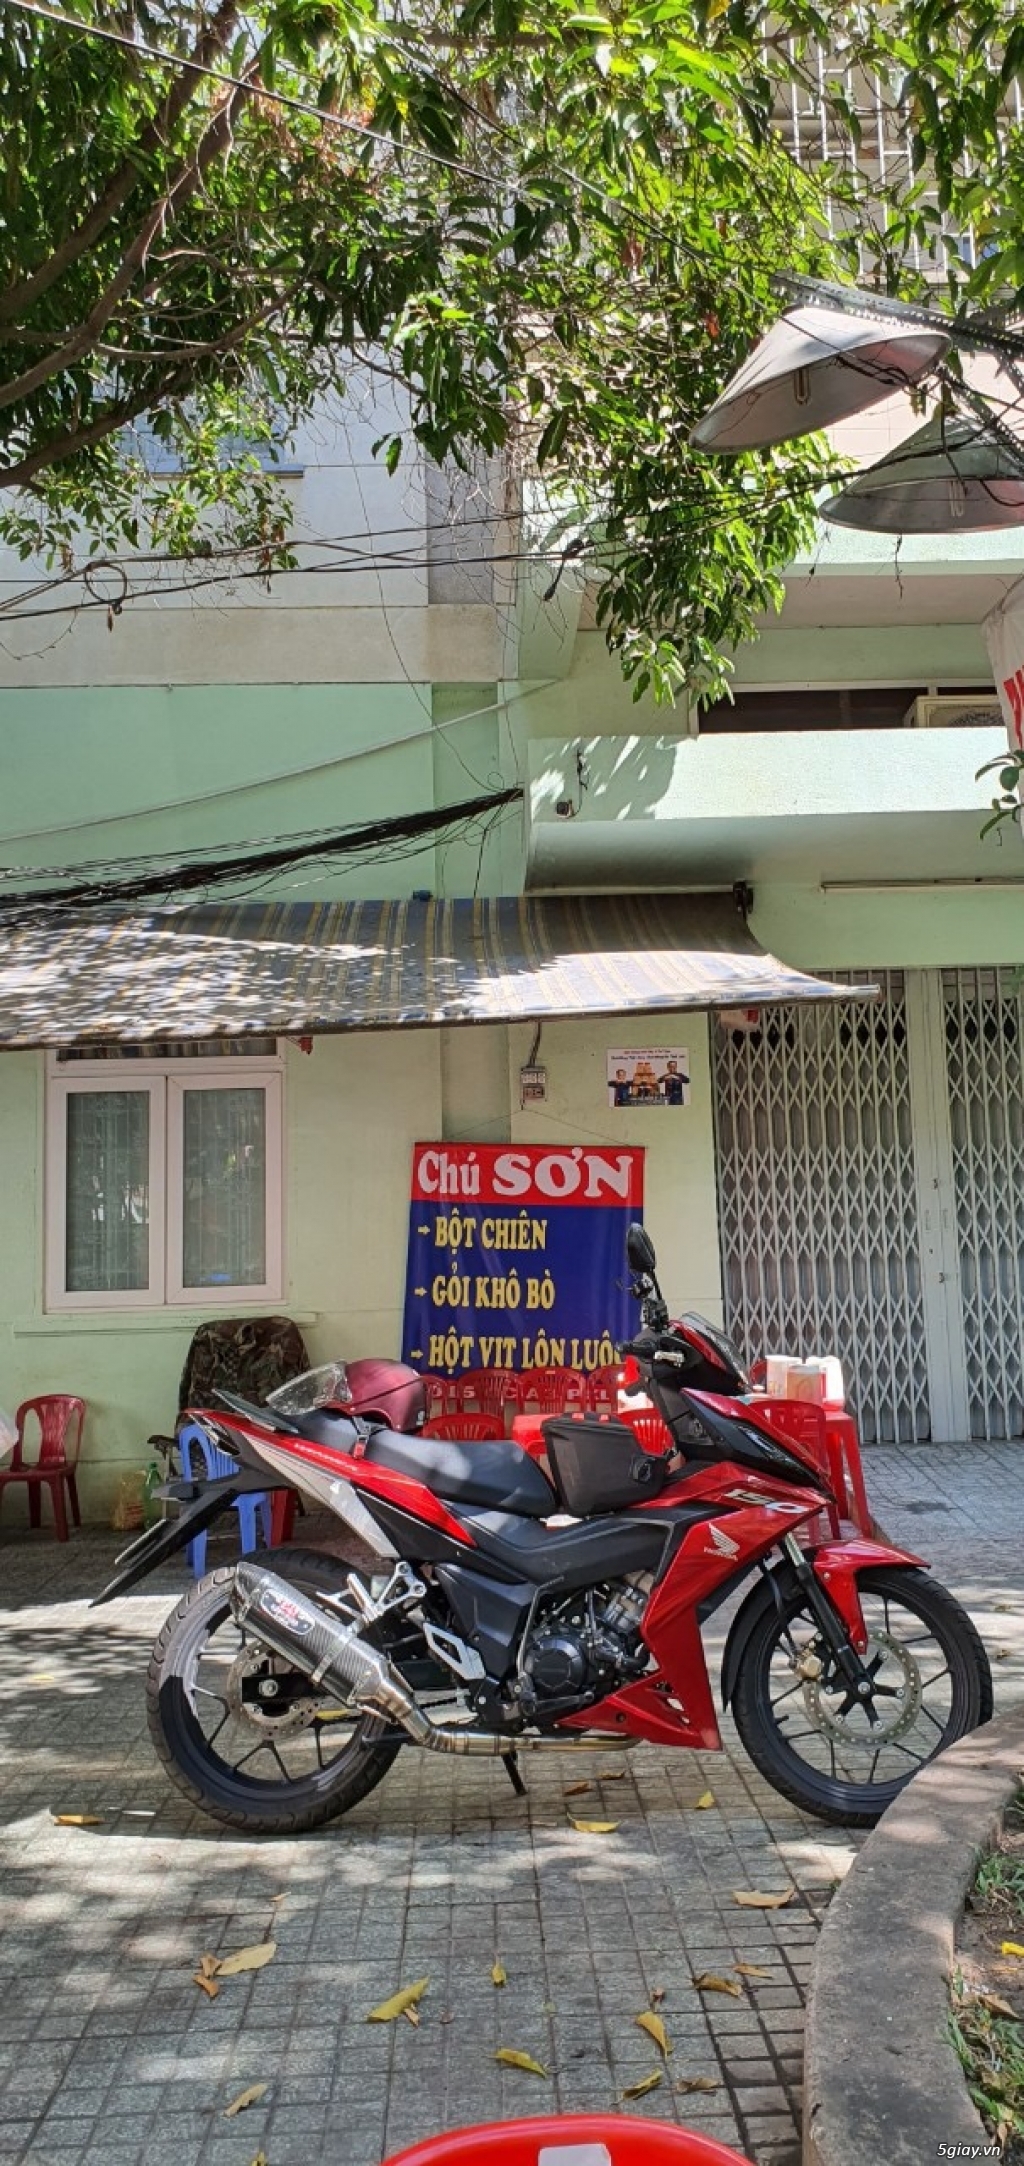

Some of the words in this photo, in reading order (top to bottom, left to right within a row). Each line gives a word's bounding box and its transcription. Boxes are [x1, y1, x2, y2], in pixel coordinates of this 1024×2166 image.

[417, 1150, 480, 1196] Chú
[492, 1147, 634, 1198] SƠN
[434, 1207, 477, 1255] BỘT
[481, 1209, 547, 1250] CHIÊN
[432, 1262, 471, 1308] GỎI
[474, 1267, 521, 1309] KHÔ
[526, 1269, 556, 1311] BÒ
[428, 1326, 475, 1375] HỘT
[521, 1328, 566, 1370] LÔN
